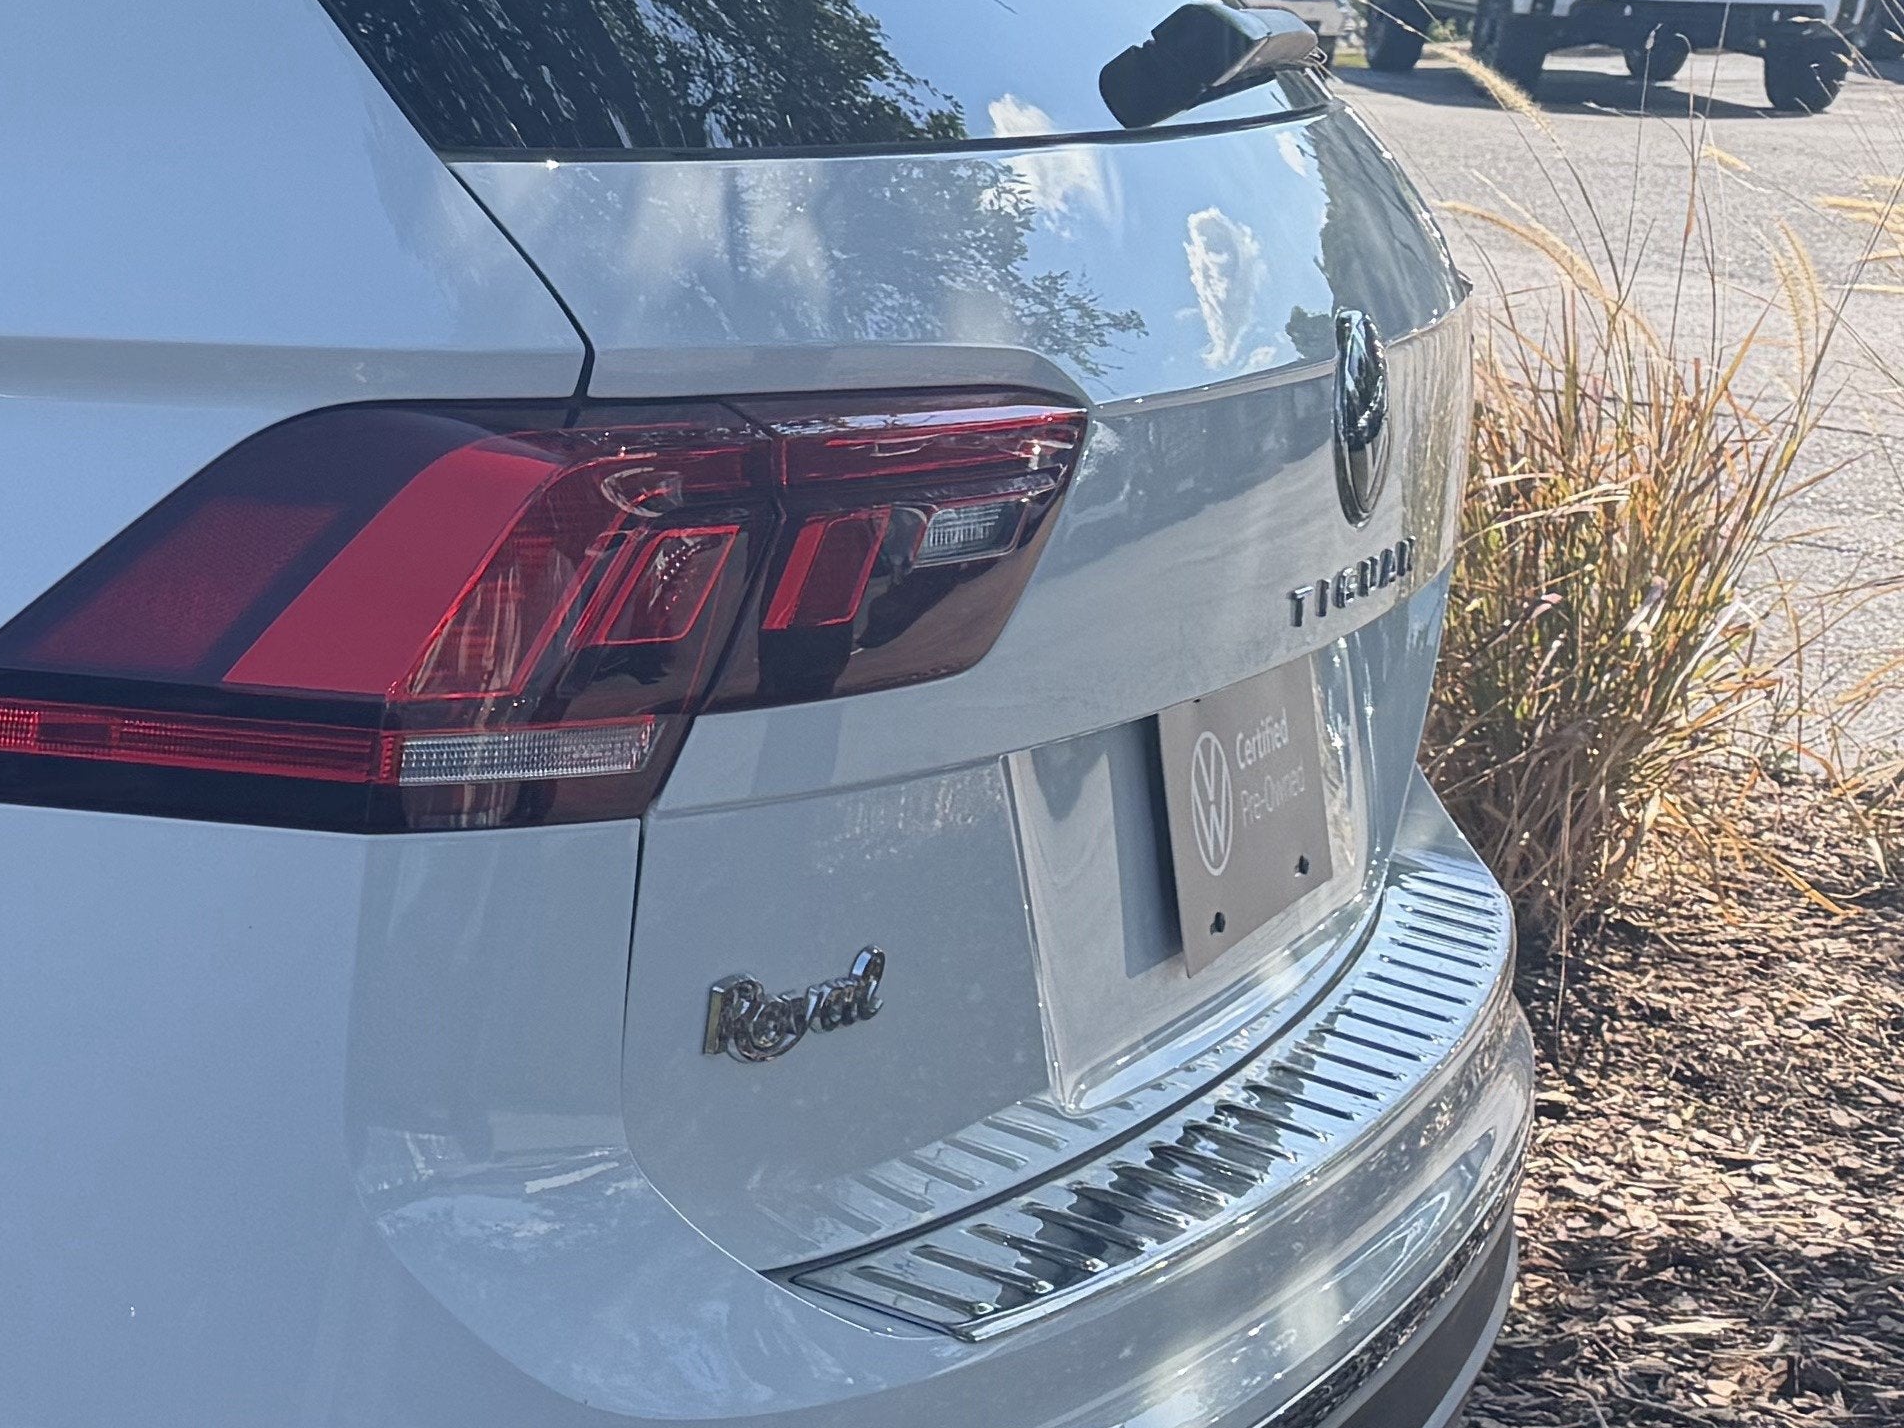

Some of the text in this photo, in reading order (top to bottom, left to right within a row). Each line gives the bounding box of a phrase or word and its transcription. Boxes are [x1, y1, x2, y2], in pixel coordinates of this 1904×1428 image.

[1236, 706, 1290, 770] Certified
[1241, 758, 1305, 828] Pre-Owned
[702, 943, 885, 1064] Royal
